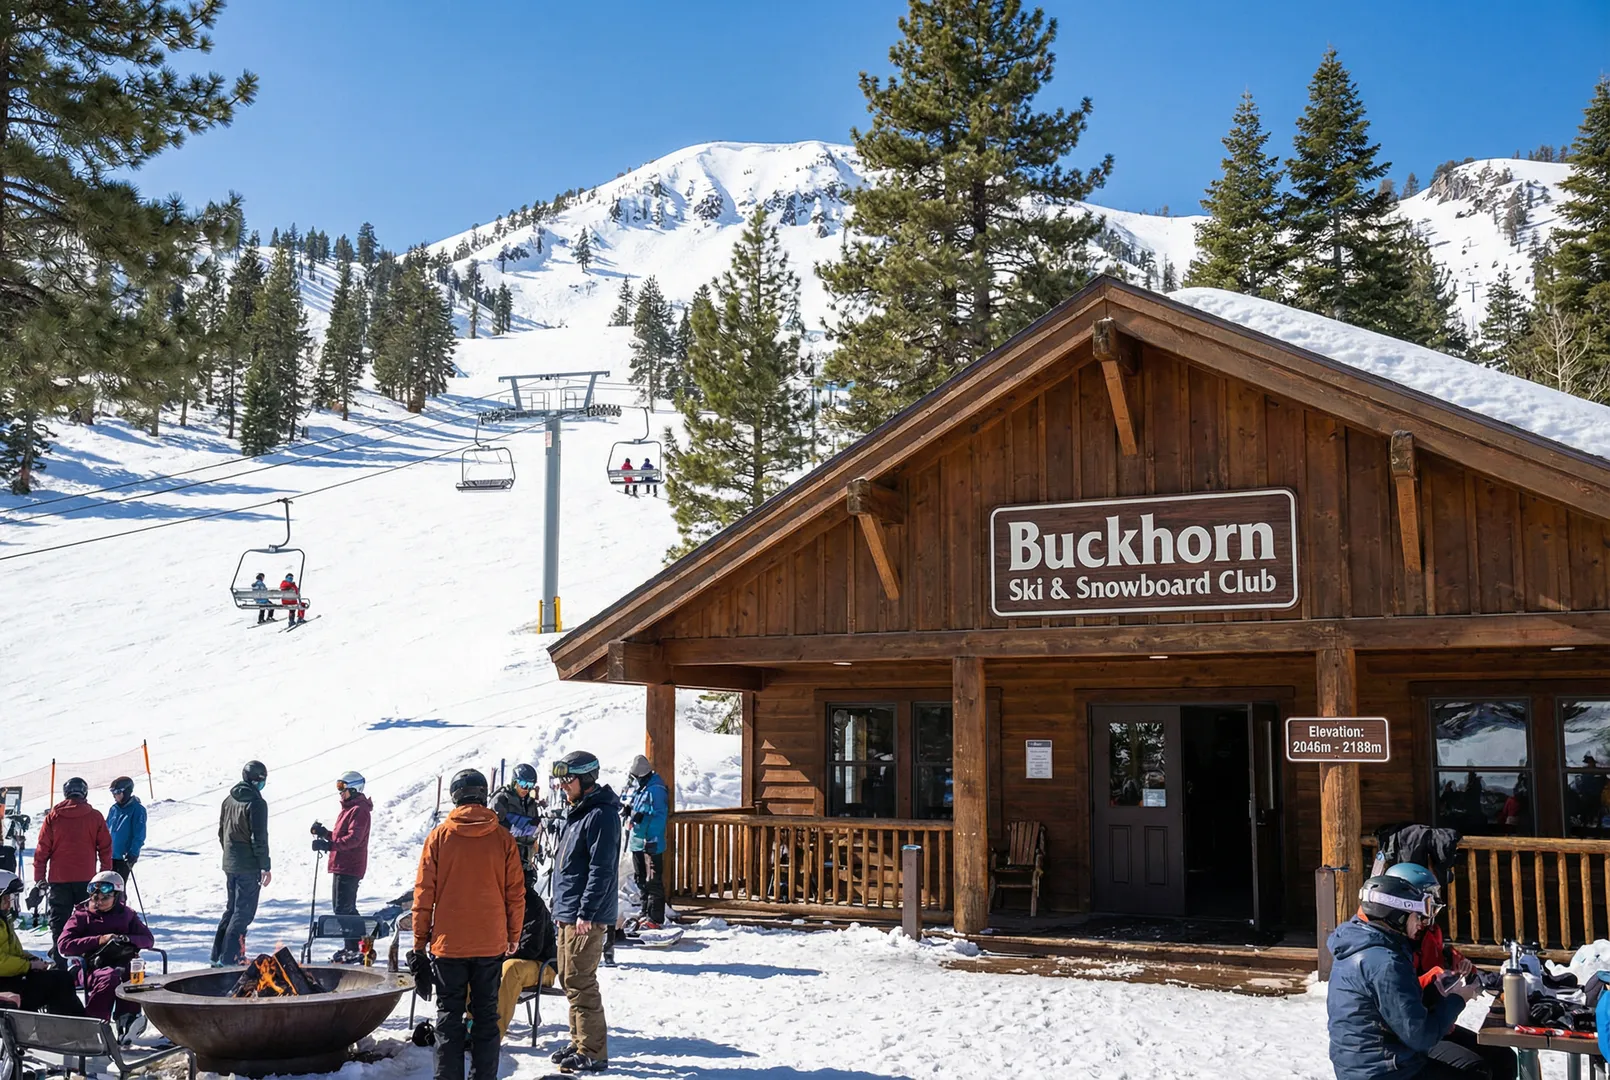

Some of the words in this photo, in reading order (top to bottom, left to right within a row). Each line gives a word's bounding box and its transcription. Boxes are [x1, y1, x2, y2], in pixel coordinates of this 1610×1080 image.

[1008, 513, 1277, 571] Buckhorn
[1009, 577, 1043, 601] Ski
[1050, 577, 1071, 599] &
[1076, 571, 1211, 599] Snowboard
[1218, 568, 1277, 594] Club
[1308, 725, 1364, 738] Elevation:
[1293, 741, 1331, 753] 2046m
[1342, 741, 1382, 753] 2188m
